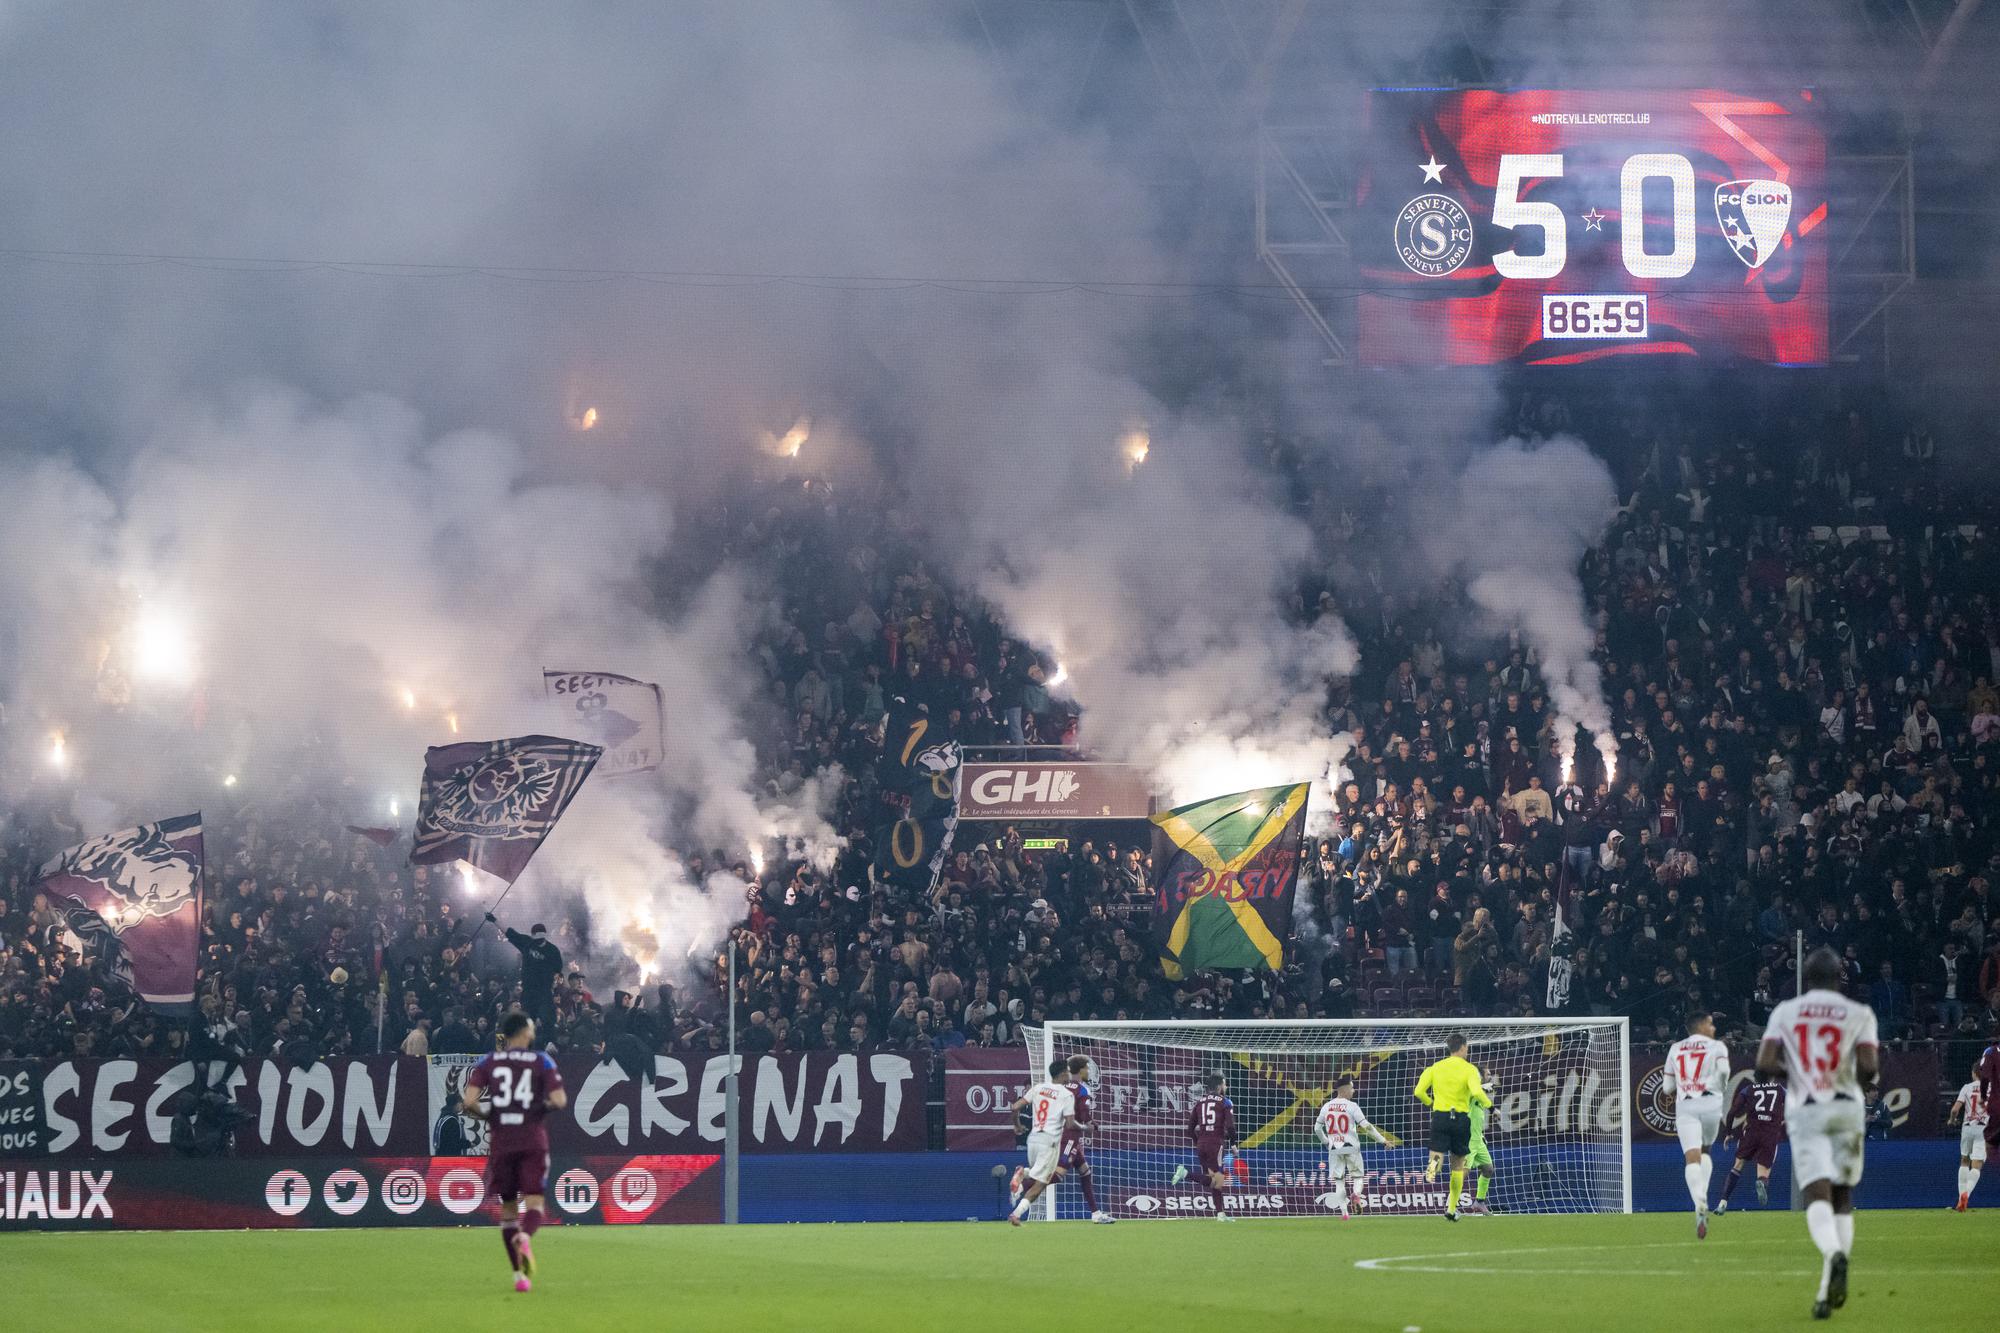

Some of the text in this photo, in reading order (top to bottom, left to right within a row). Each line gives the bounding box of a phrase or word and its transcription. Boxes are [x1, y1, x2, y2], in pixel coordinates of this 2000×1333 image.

[1531, 113, 1650, 125] #NOTREVILLENOTRECLUB
[1403, 198, 1463, 223] SERVETTE
[1717, 193, 1789, 206] FC SION
[1491, 153, 1696, 279] 5 0
[1420, 213, 1447, 256] S
[1450, 228, 1470, 242] FC
[1402, 246, 1466, 273] GENEVE 1890
[1548, 301, 1645, 334] 86:59
[970, 769, 1072, 805] GHI
[1792, 1023, 1842, 1073] 13
[1676, 1053, 1707, 1082] 17
[492, 1066, 534, 1110] 34
[574, 1053, 914, 1148] GRENAT
[1483, 1068, 1622, 1133] eille
[1753, 1089, 1778, 1112] 27
[1037, 1099, 1050, 1123] 8
[1201, 1101, 1216, 1125] 15
[1326, 1113, 1349, 1135] 20
[1267, 1161, 1436, 1186] swicom
[1165, 1194, 1284, 1211] SECURITAS
